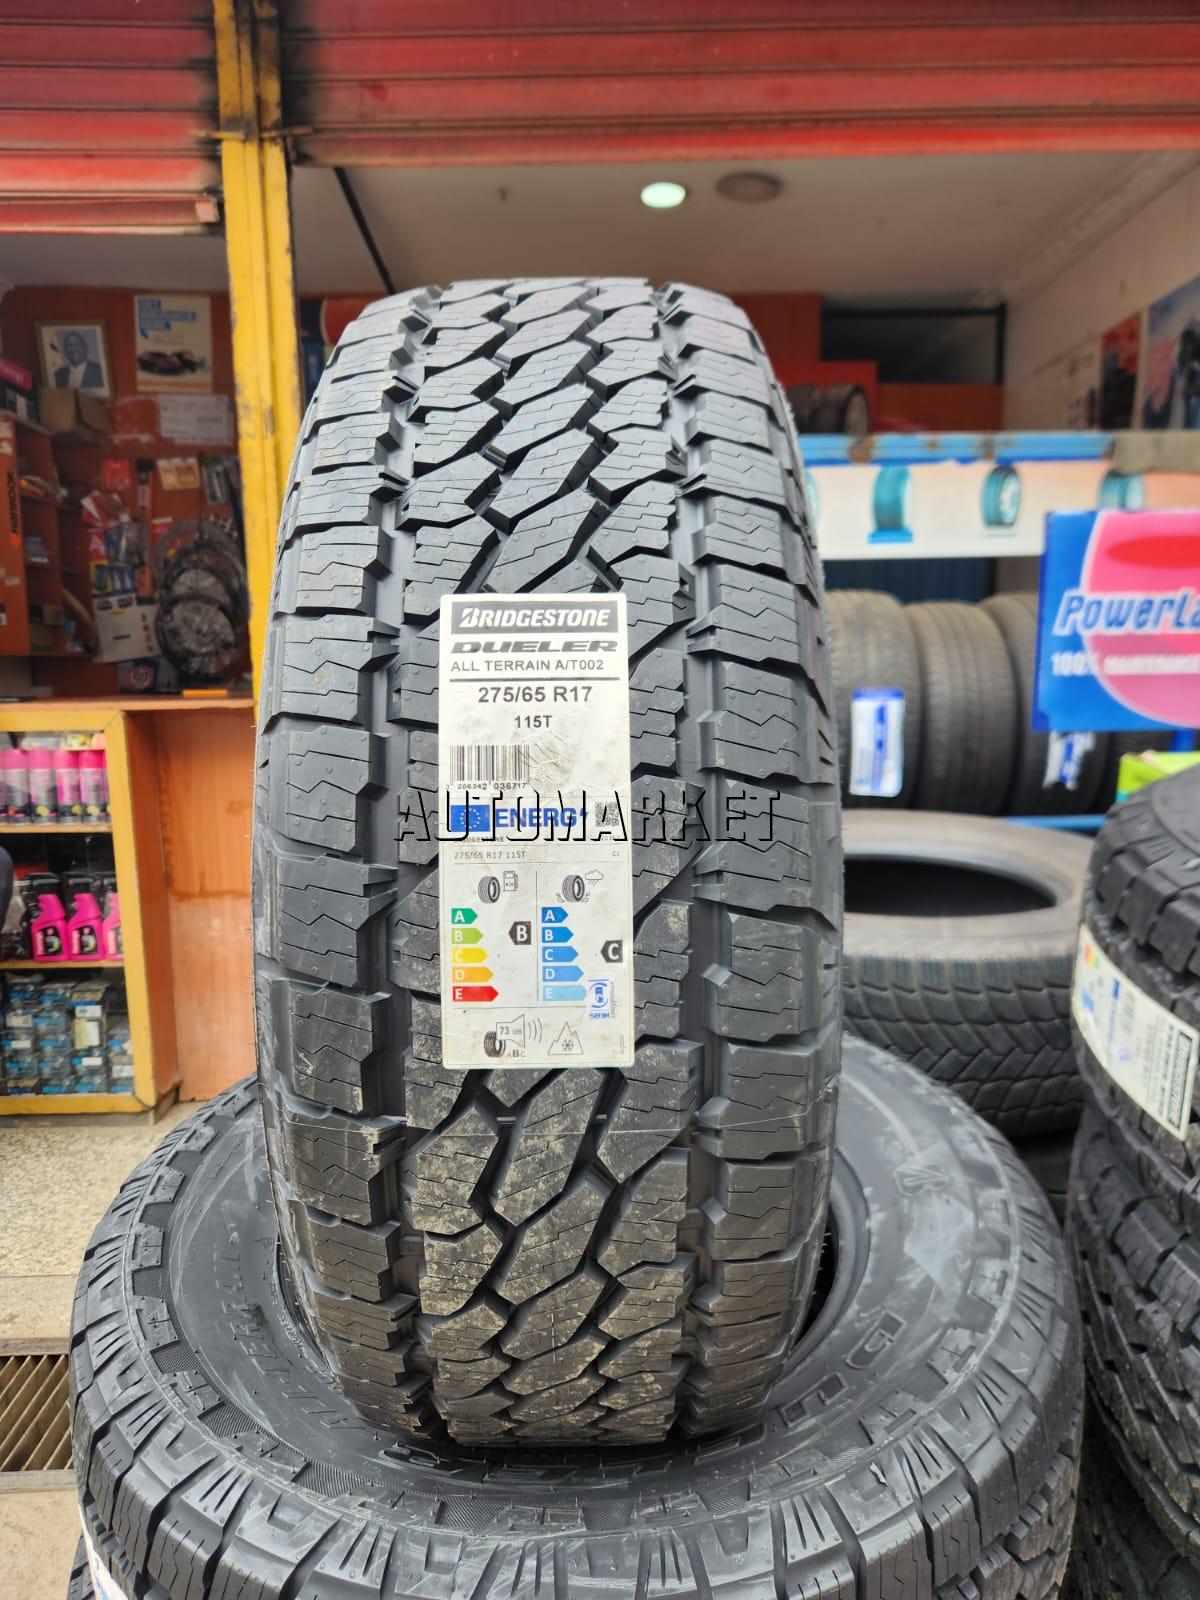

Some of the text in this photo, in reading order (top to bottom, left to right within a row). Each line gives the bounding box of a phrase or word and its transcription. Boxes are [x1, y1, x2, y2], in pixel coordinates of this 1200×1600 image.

[458, 607, 611, 628] BRIDGESTONE
[450, 640, 619, 654] DUELER
[450, 659, 605, 672] ALL TERRAIN A/T002
[477, 686, 593, 703] 275/65 R17
[514, 714, 553, 729] 115T
[454, 851, 484, 860] 275/65
[486, 851, 502, 859] R17
[506, 851, 526, 859] 115T
[454, 910, 465, 922] A
[544, 910, 556, 922] A
[454, 930, 464, 941] B
[516, 925, 528, 942] B
[544, 929, 554, 941] B
[454, 950, 464, 961] C
[544, 949, 554, 960] C
[607, 943, 619, 960] C
[455, 969, 465, 980] D
[545, 968, 555, 980] D
[455, 988, 463, 1000] E
[545, 988, 553, 999] E
[499, 1025, 510, 1036] 73
